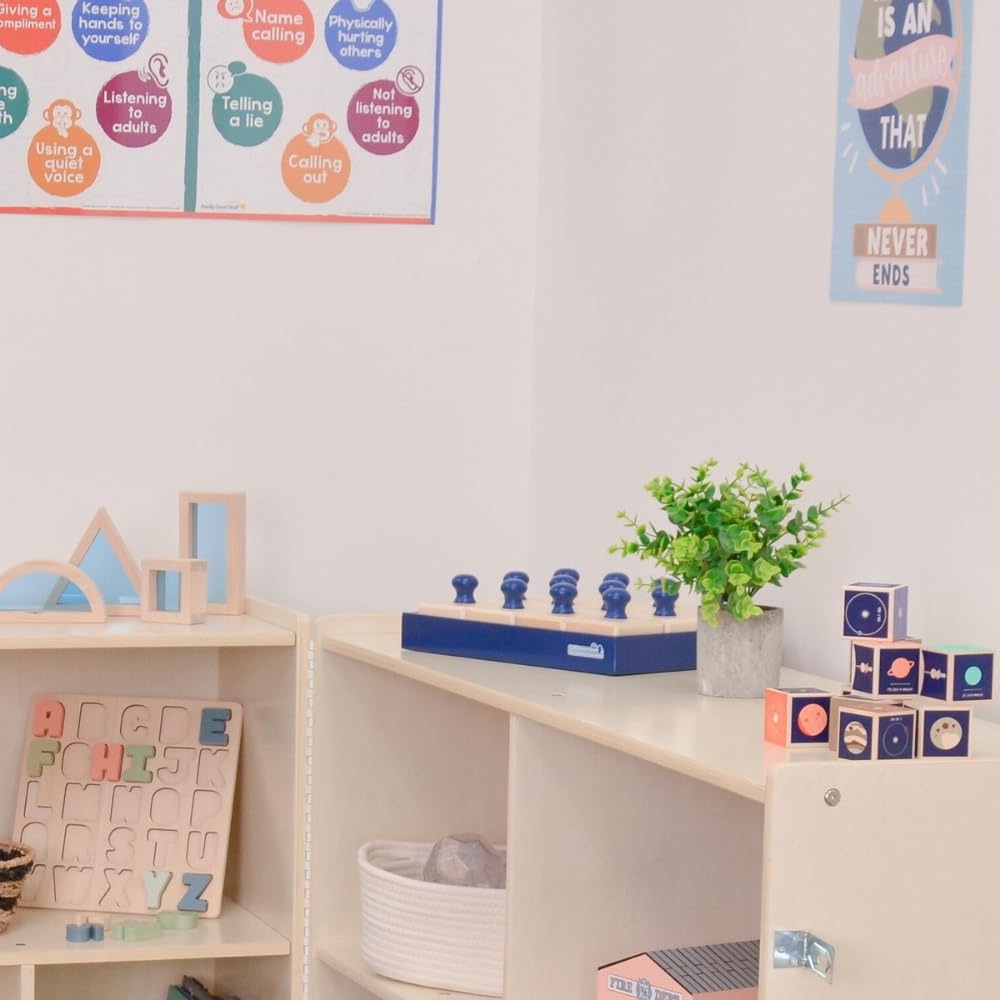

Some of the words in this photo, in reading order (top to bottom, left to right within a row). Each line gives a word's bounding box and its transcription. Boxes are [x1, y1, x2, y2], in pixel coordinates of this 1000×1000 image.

[42, 7, 52, 16] a
[82, 2, 140, 18] Keeping
[255, 9, 304, 25] Name
[78, 16, 124, 31] hands
[129, 17, 143, 31] to
[329, 15, 393, 32] Physically
[877, 6, 896, 38] IS
[902, 0, 933, 35] AN
[82, 32, 140, 47] yourself
[252, 27, 306, 45] calling
[338, 30, 384, 47] hurting
[340, 46, 382, 58] others
[103, 90, 167, 108] Listening
[373, 87, 396, 101] Not
[128, 106, 142, 119] to
[222, 95, 273, 113] Telling
[355, 101, 412, 118] listening
[112, 120, 157, 134] adults
[229, 116, 240, 128] a
[246, 114, 264, 128] lie
[376, 116, 390, 129] to
[362, 131, 405, 144] adults
[880, 113, 927, 149] THAT
[36, 142, 77, 159] Using
[82, 145, 93, 156] a
[45, 156, 84, 173] quiet
[288, 154, 343, 173] Calling
[44, 171, 84, 184] voice
[303, 171, 328, 184] out
[867, 226, 929, 256] NEVER
[872, 263, 911, 286] ENDS
[199, 708, 231, 746] E
[27, 740, 61, 777] F
[177, 873, 212, 912] Z
[610, 976, 633, 994] FIRE
